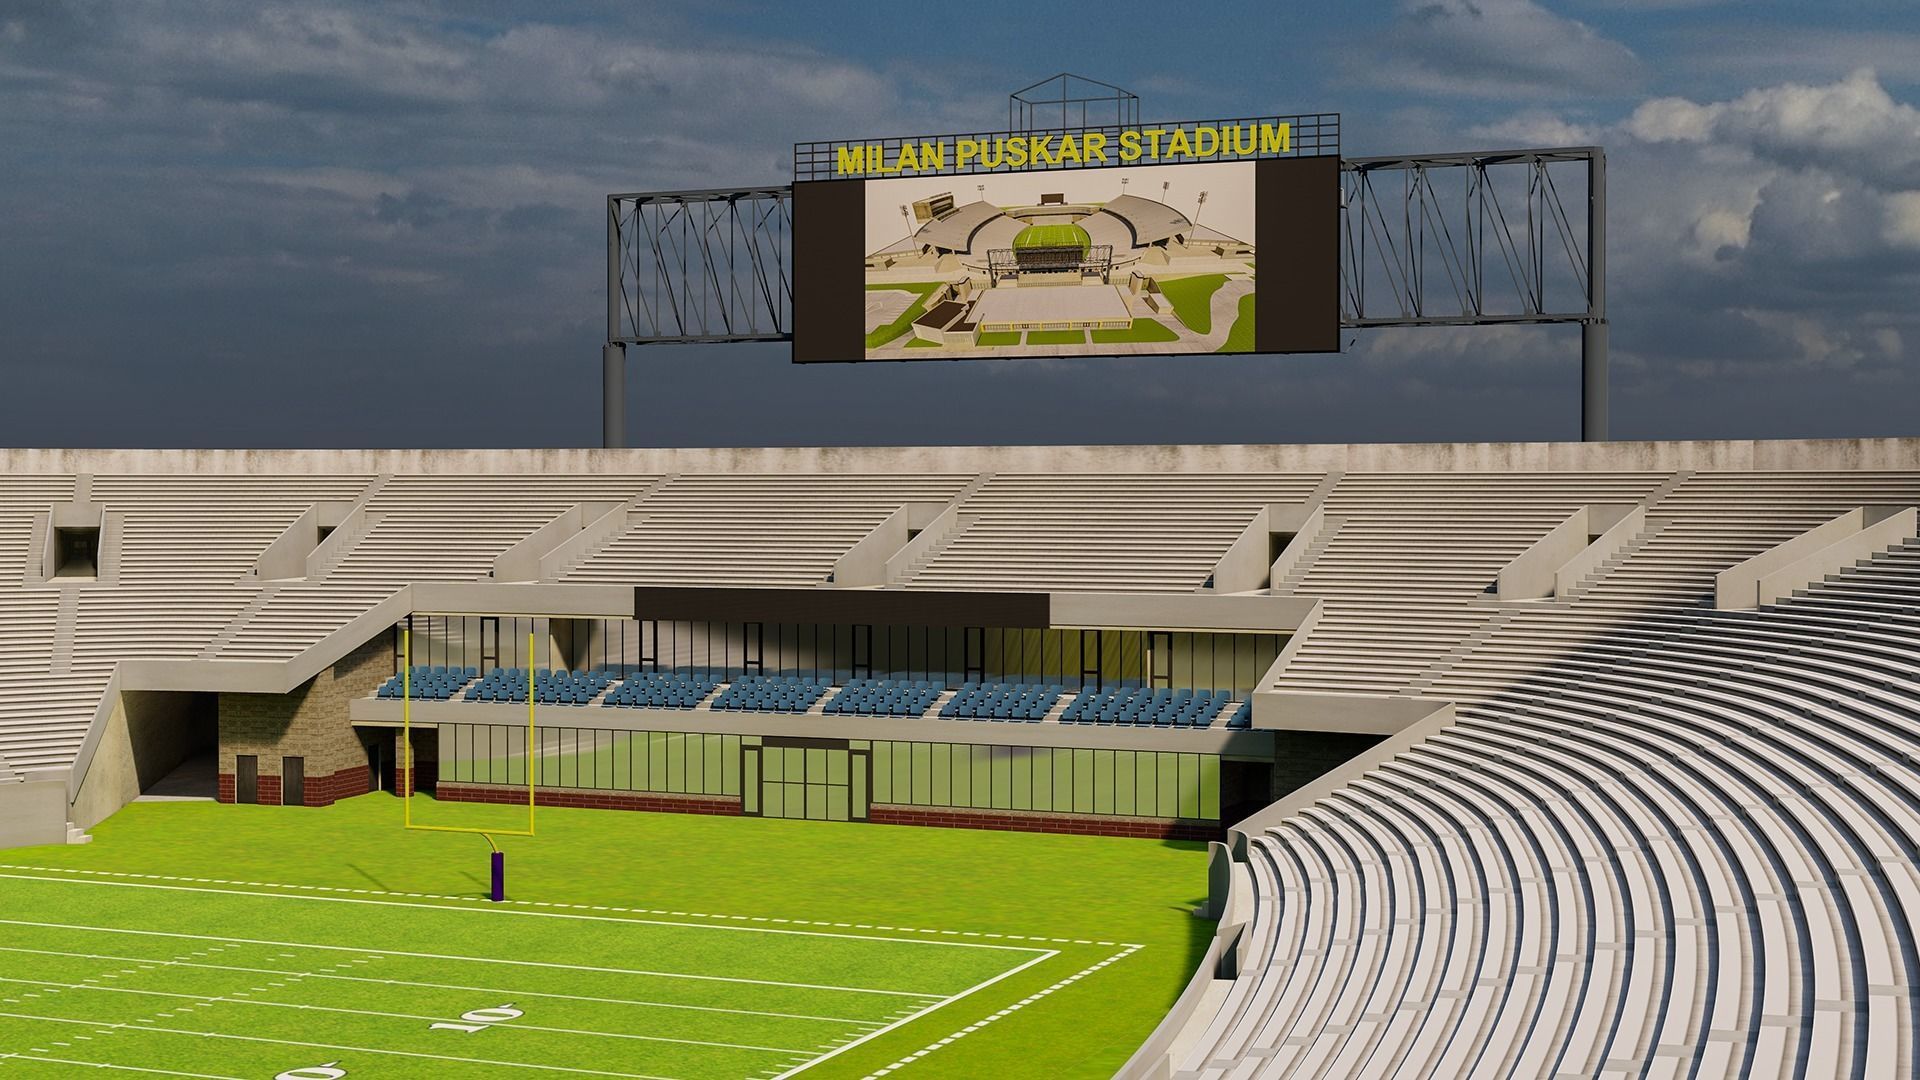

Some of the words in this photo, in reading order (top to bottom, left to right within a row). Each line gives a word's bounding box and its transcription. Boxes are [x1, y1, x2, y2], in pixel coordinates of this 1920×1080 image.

[837, 143, 945, 174] MILAN
[956, 132, 1107, 169] PUSKAR
[1119, 123, 1291, 161] STADIUM
[427, 1007, 525, 1033] 10
